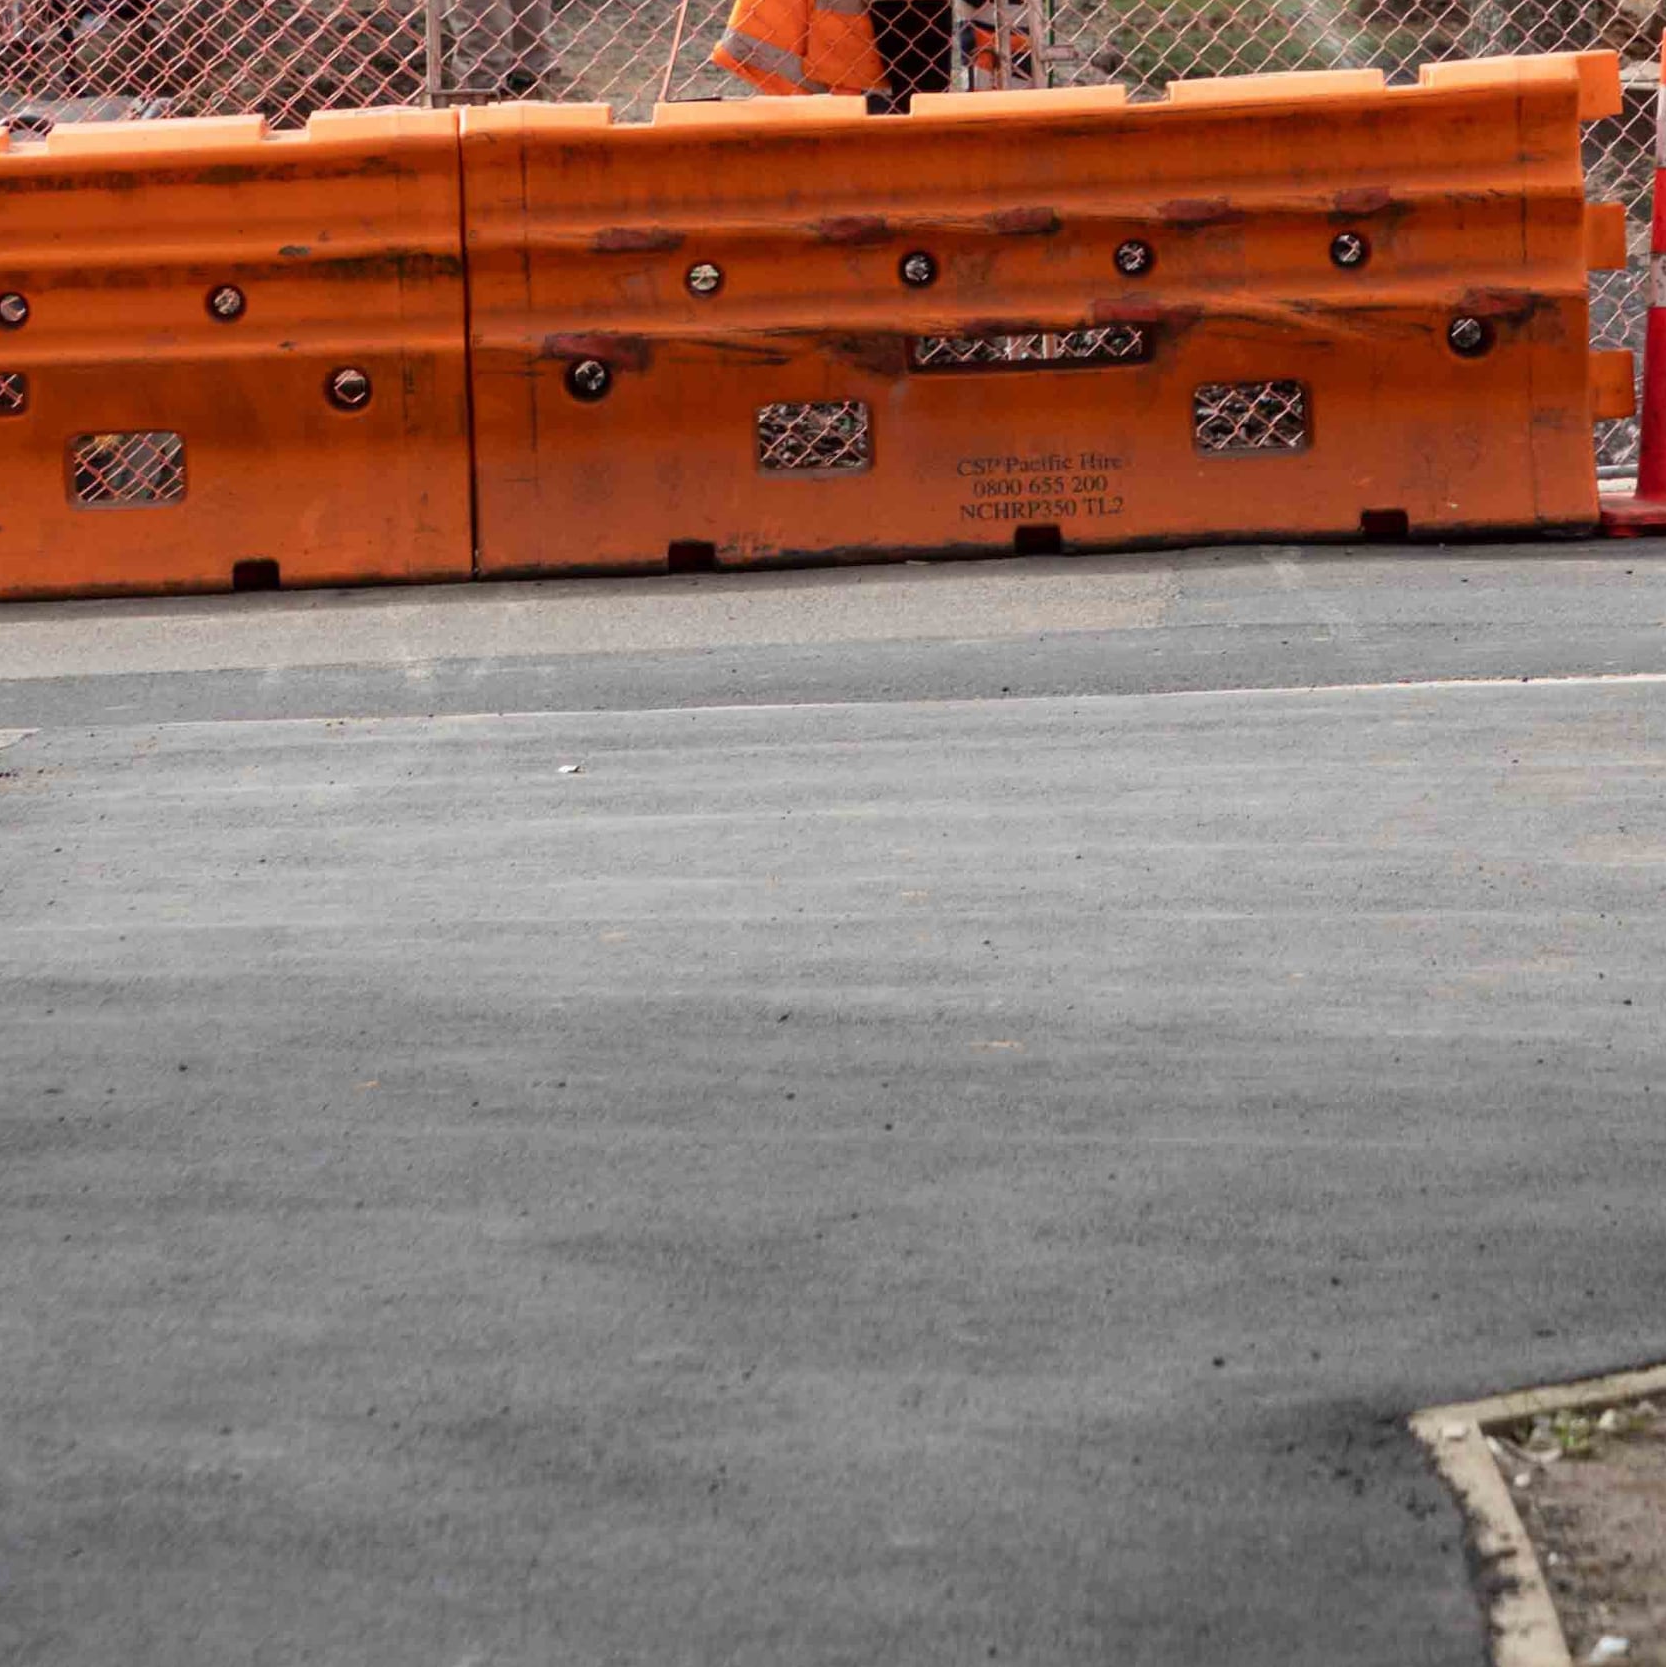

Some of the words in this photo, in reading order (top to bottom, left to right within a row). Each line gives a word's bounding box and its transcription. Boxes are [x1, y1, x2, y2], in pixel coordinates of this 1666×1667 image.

[957, 457, 1001, 476] CSP
[1006, 454, 1073, 474] Pacific
[1080, 452, 1123, 471] Hire
[973, 478, 1022, 497] 0800
[1029, 477, 1064, 495] 655
[1073, 475, 1108, 493] 200
[960, 499, 1077, 520] NCHRP350
[1081, 496, 1124, 516] TL2
